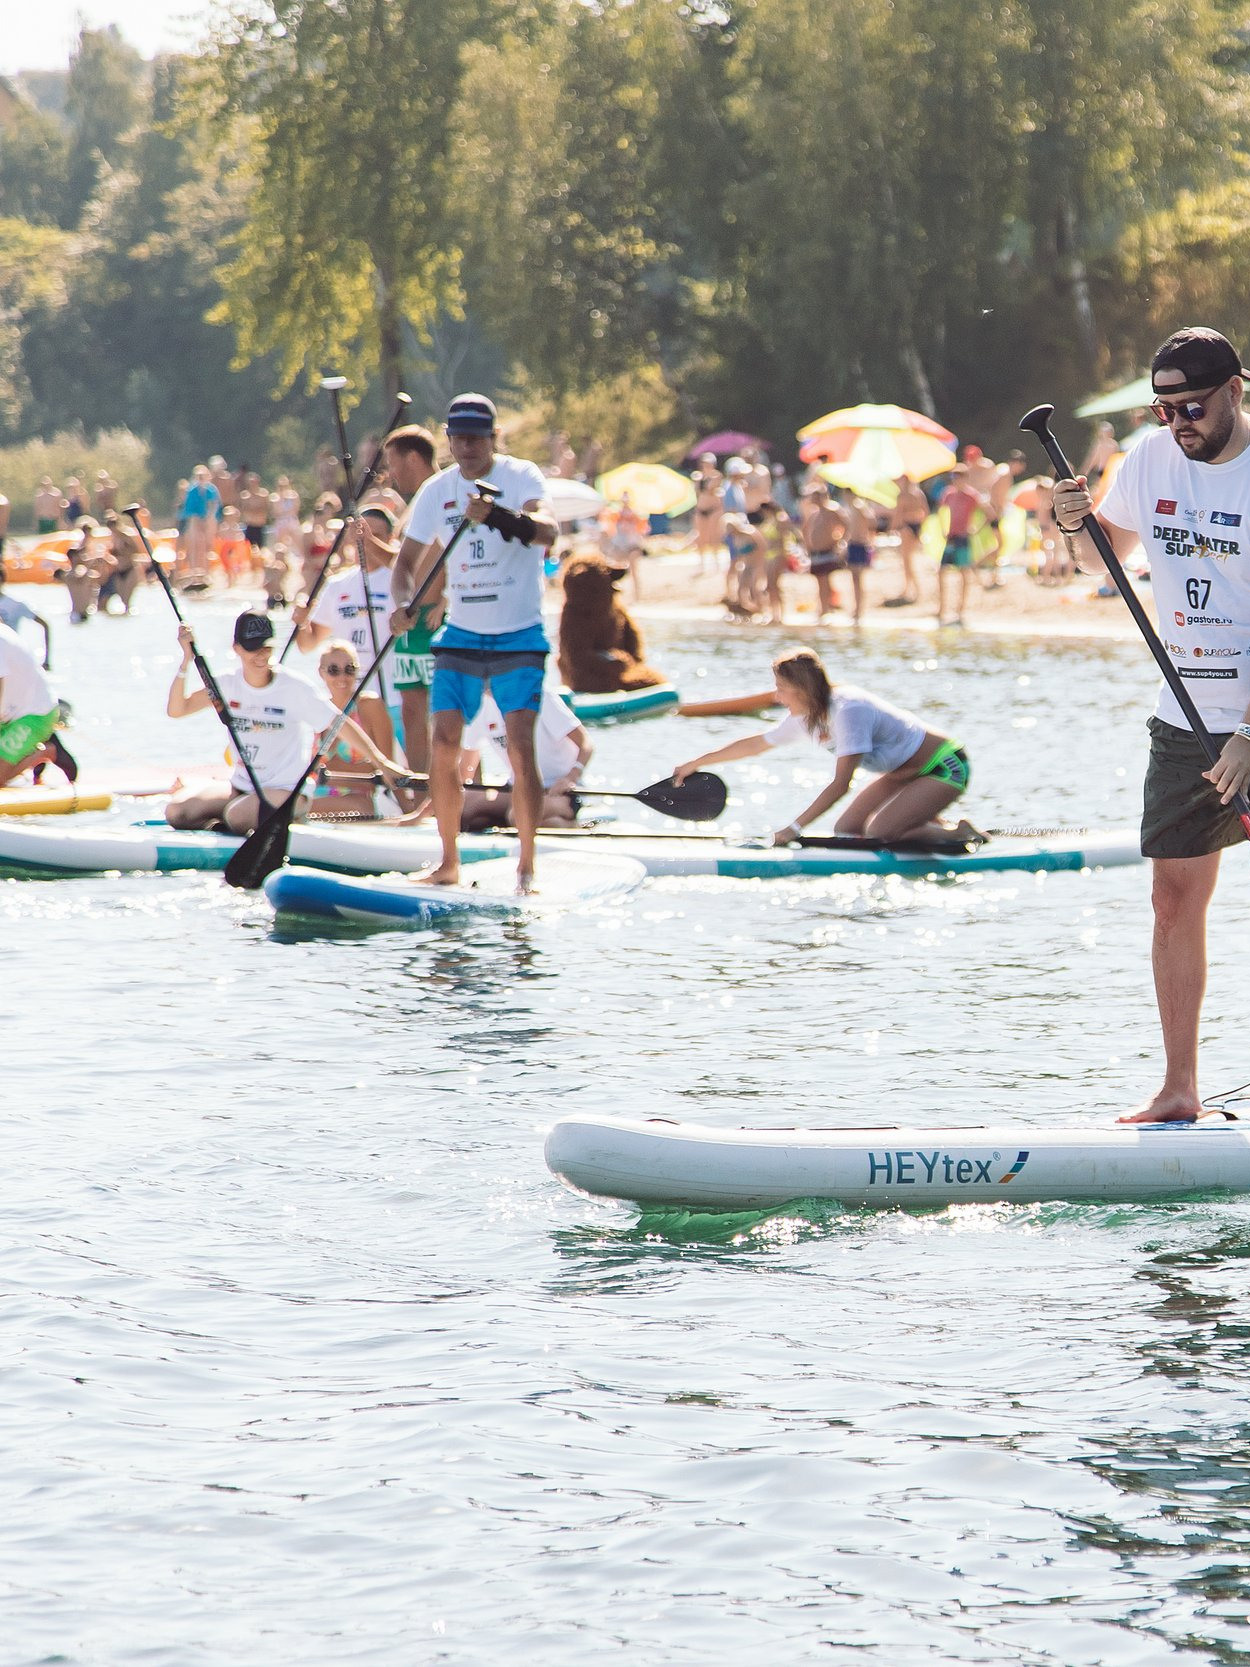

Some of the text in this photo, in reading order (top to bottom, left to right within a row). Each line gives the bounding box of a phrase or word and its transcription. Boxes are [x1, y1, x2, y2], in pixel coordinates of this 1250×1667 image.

[1153, 525, 1241, 555] DEEP WATER
[1165, 542, 1196, 557] SUP
[1186, 578, 1211, 610] 67
[1187, 615, 1232, 625] gastore.ru
[1181, 670, 1233, 678] www.sup4you.ru
